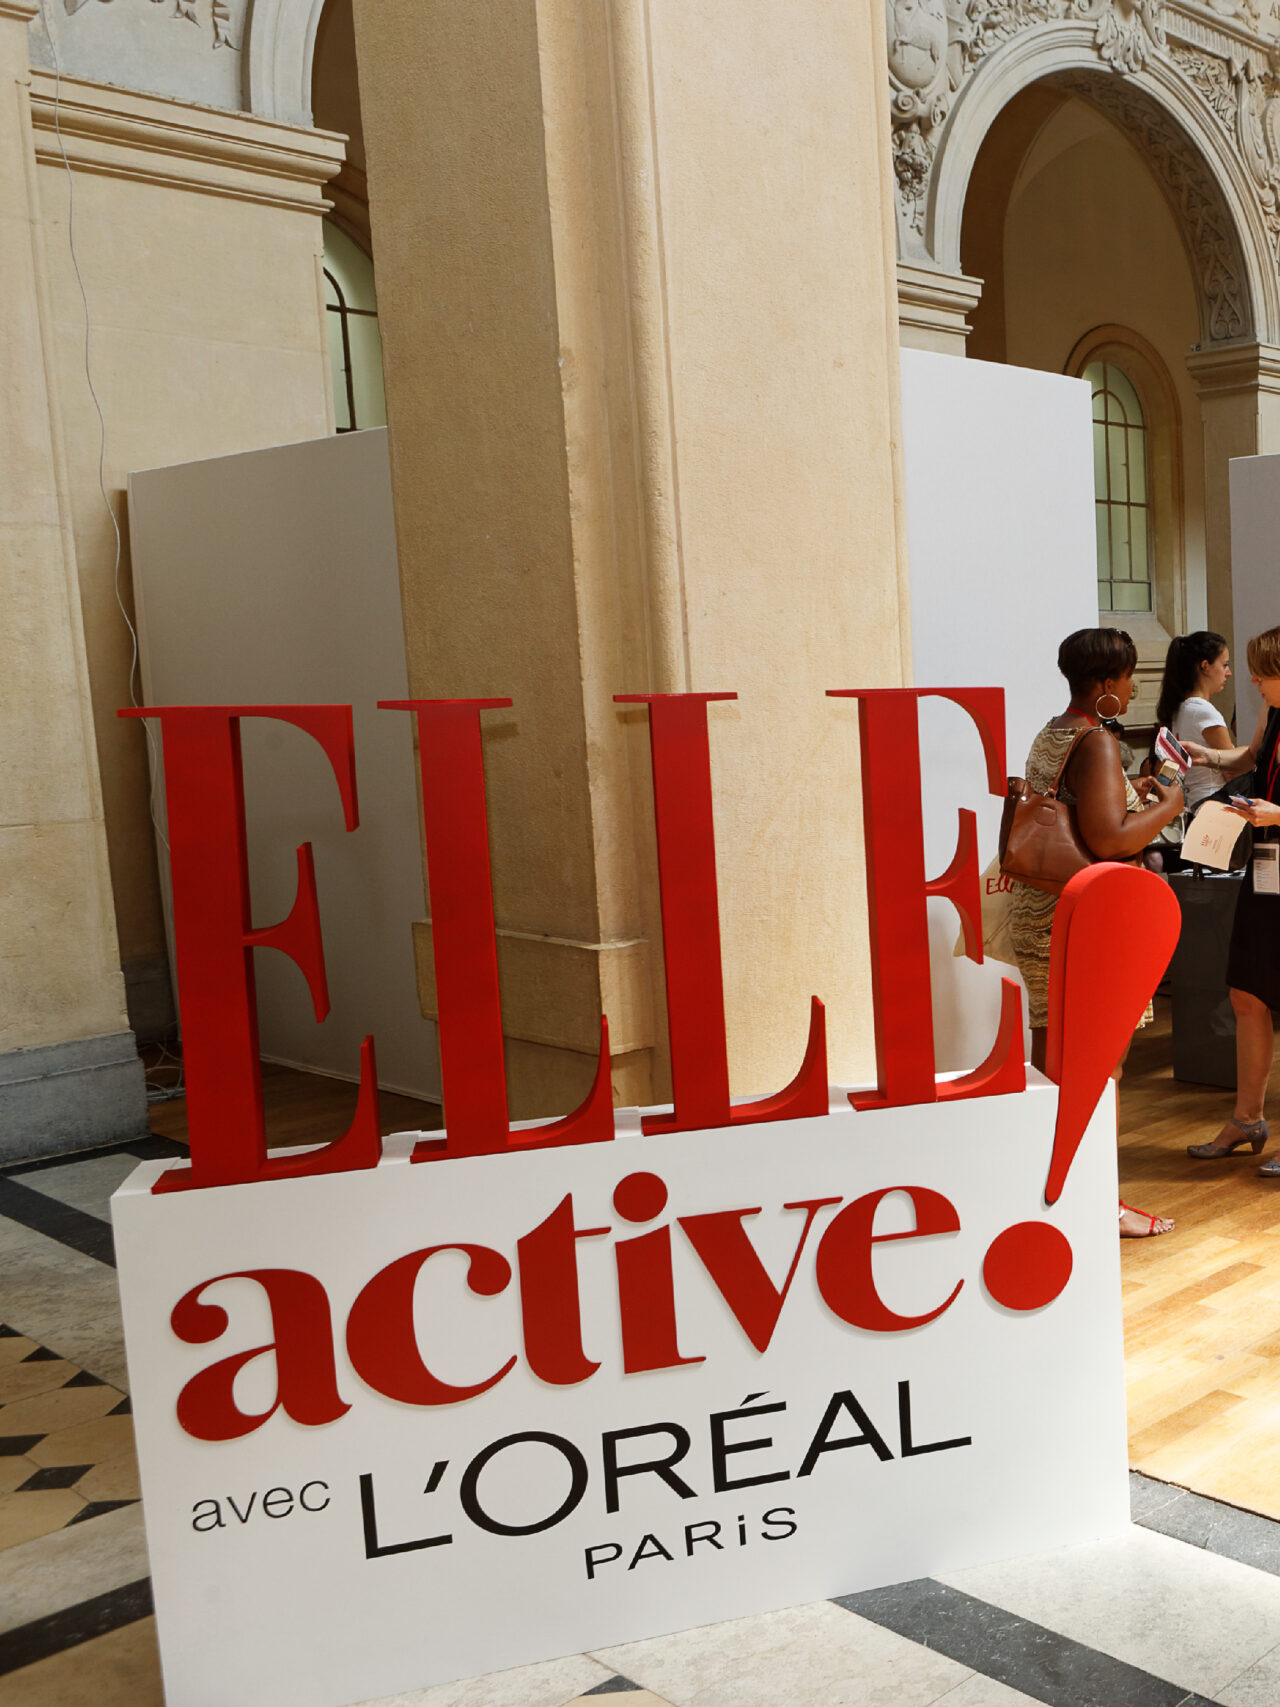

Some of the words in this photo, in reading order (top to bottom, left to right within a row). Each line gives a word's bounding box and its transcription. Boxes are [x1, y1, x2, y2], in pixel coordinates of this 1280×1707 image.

[115, 686, 1028, 1196] ELLE
[190, 1475, 332, 1533] avec
[360, 1381, 972, 1560] L'ORÉAL
